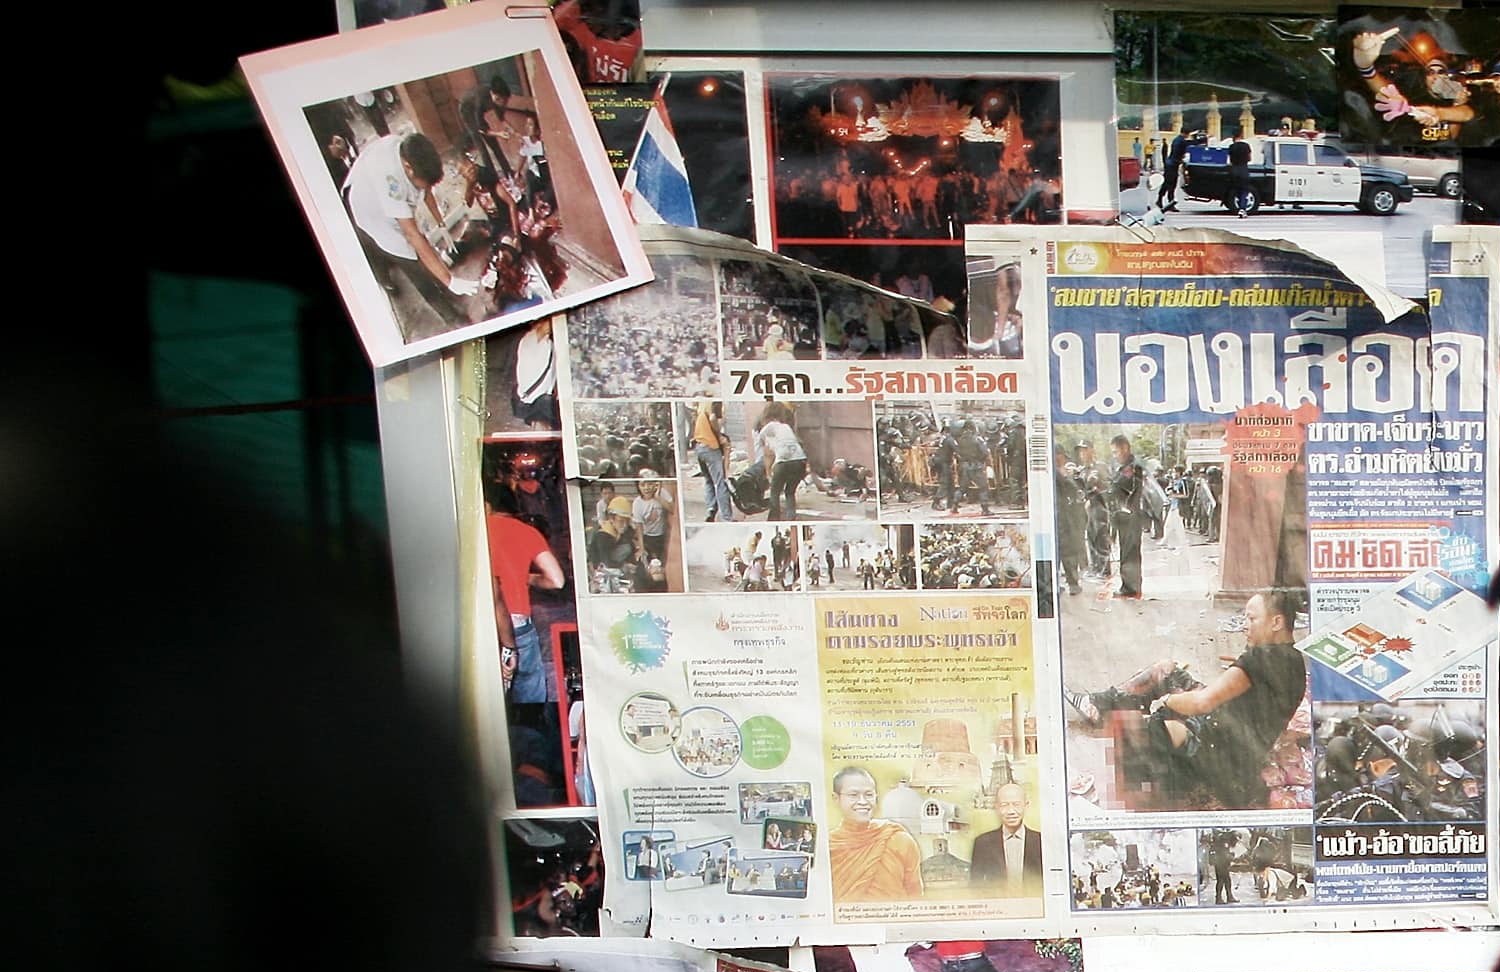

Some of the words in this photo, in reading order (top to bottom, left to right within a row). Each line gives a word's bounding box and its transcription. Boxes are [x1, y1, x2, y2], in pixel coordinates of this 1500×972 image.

[1052, 306, 1485, 415] นองเลือด
[1235, 414, 1293, 426] นาทีต่อนาที
[896, 719, 916, 727] 2551
